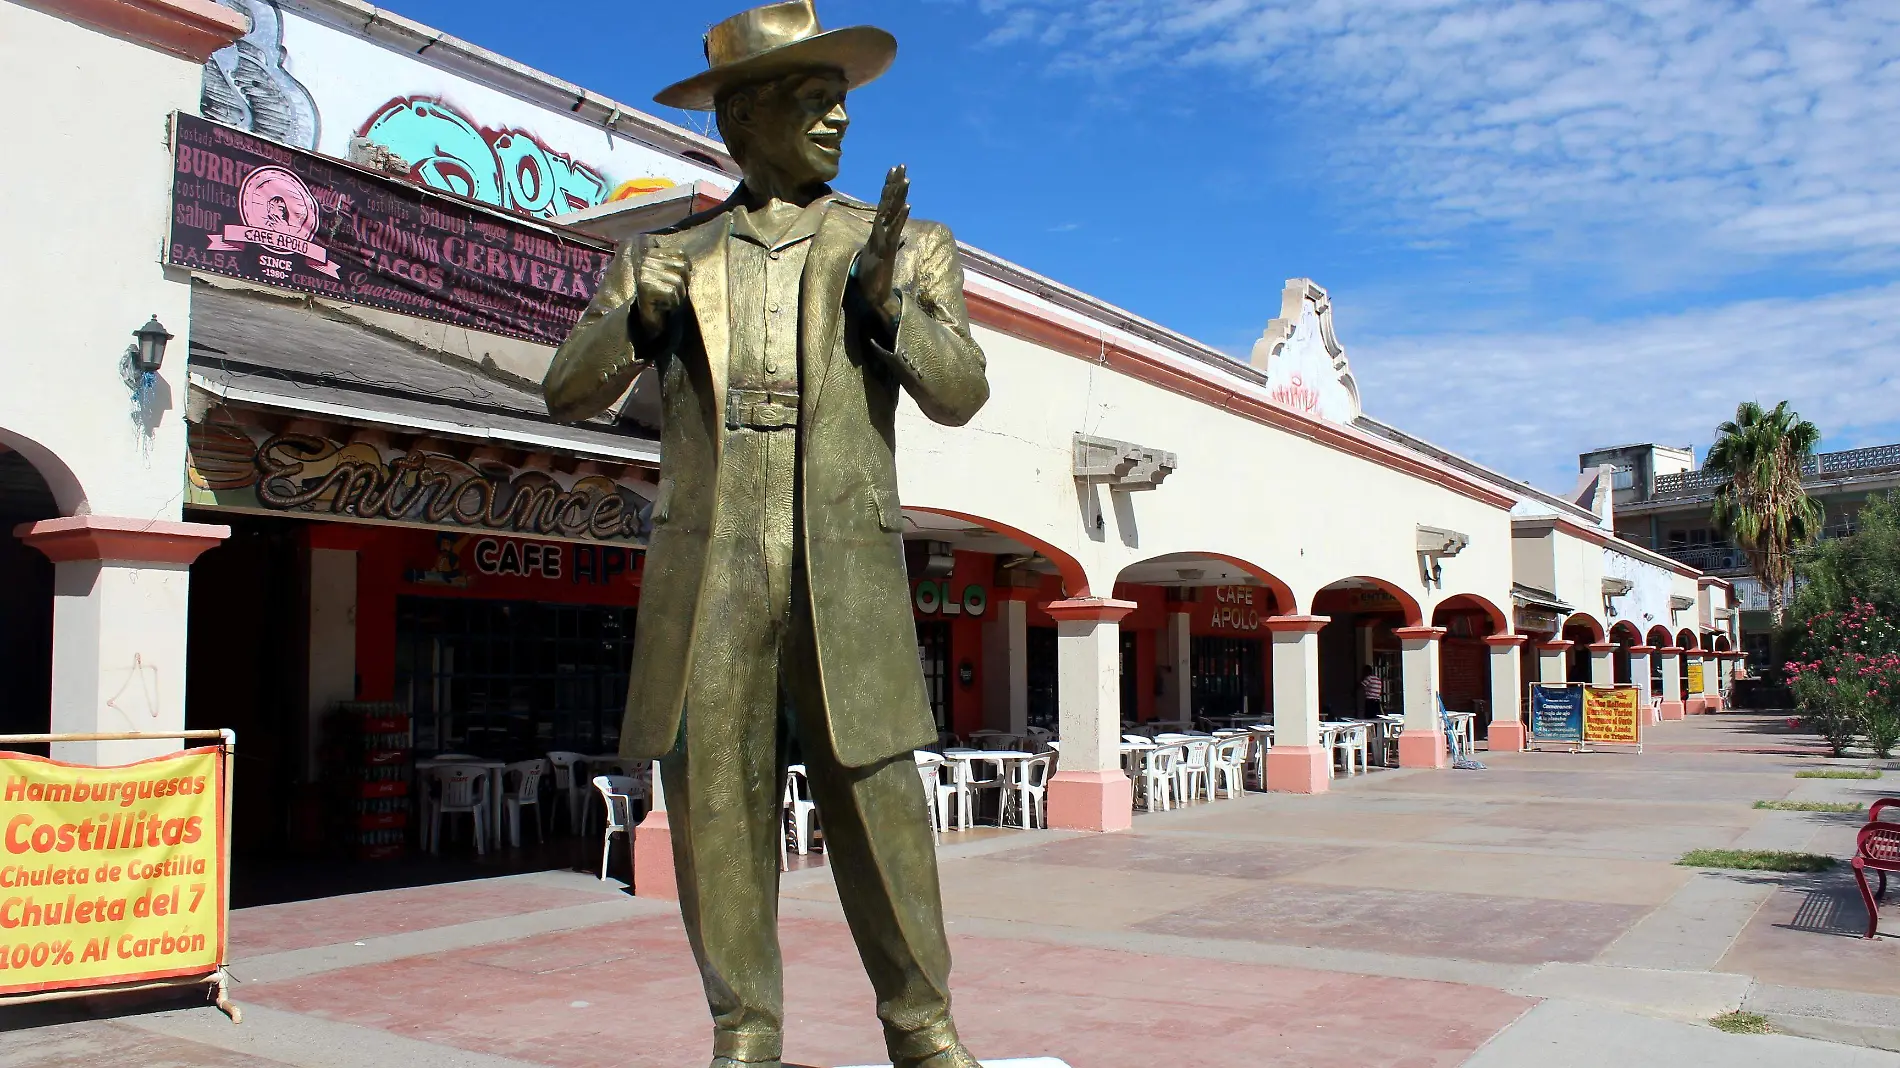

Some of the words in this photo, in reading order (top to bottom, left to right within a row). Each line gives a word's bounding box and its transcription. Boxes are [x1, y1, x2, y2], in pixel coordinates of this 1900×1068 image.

[176, 179, 237, 209] costillitas
[176, 203, 222, 232] sabor
[244, 229, 274, 245] CAFE
[276, 233, 308, 254] APOLO
[172, 243, 240, 272] SALSA
[259, 254, 293, 271] SINCE
[442, 236, 592, 300] CERVEZA
[292, 272, 346, 293] CERVEZA
[257, 432, 630, 541] Entrance
[474, 537, 563, 581] CAFE
[1216, 585, 1253, 605] CAFE
[1211, 607, 1258, 630] APOLO
[4, 774, 206, 807] Hamburguesas
[4, 810, 203, 855] Costillitas
[0, 863, 90, 888] Chuleta
[95, 863, 121, 884] de
[127, 854, 206, 882] Costilla
[0, 894, 127, 930] Chuleta
[132, 884, 179, 919] del
[188, 883, 206, 913] 7
[0, 938, 75, 970] 100%
[80, 936, 109, 963] Al
[116, 924, 206, 961] Carbón
